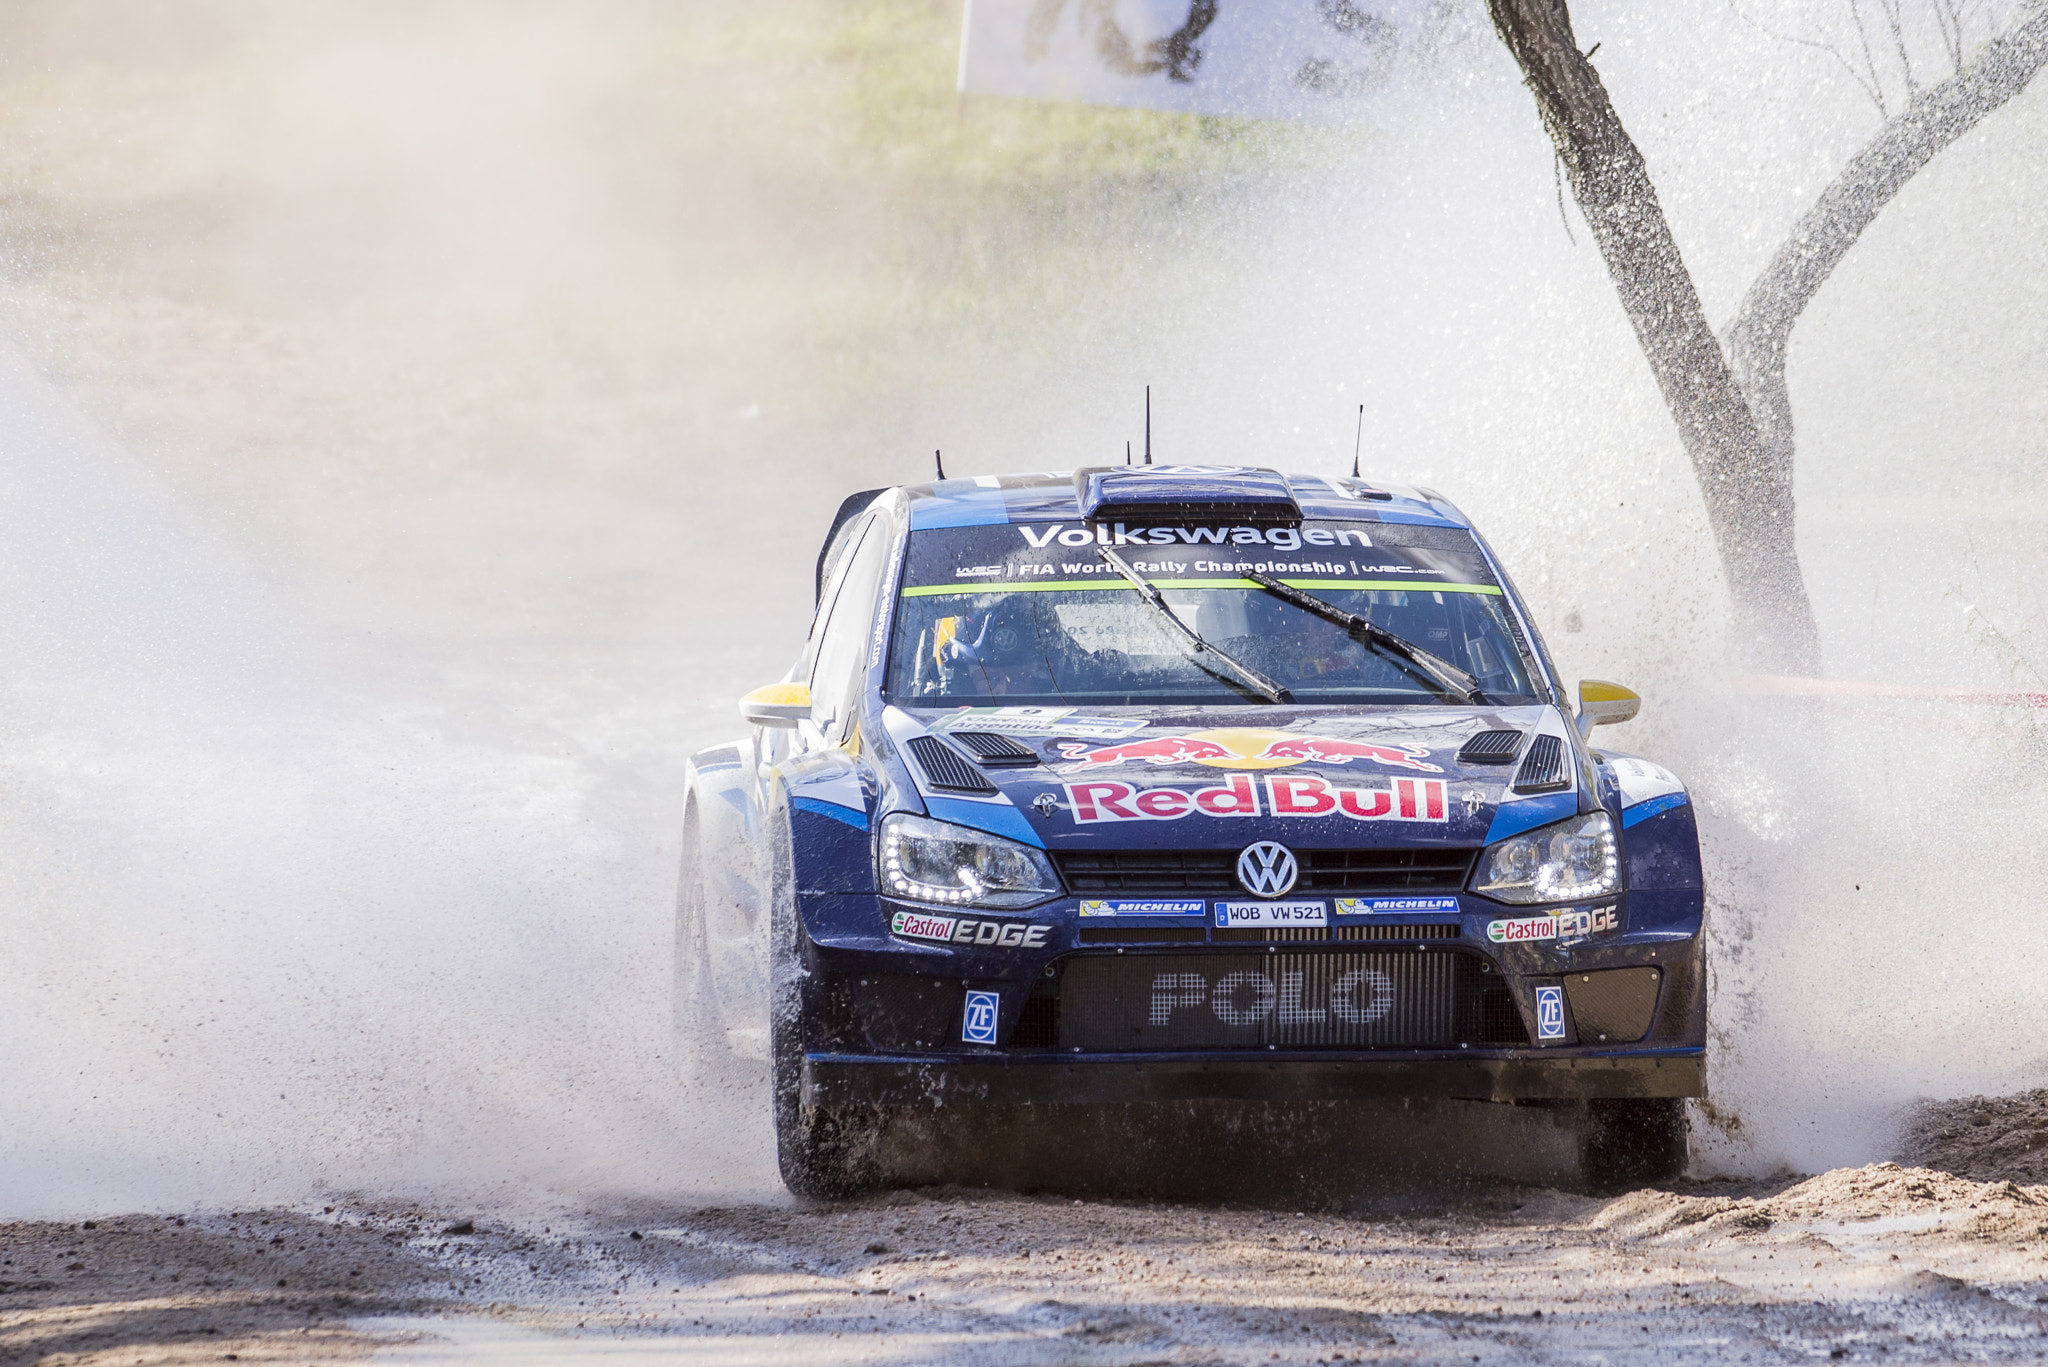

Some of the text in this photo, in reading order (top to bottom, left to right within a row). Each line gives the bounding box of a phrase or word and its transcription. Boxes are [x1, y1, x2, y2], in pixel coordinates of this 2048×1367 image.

[1018, 522, 1373, 551] Volkswagen
[1019, 564, 1056, 576] FIA
[1133, 561, 1187, 575] Rally
[1194, 560, 1347, 576] Championship
[1428, 631, 1448, 640] OMP
[950, 721, 1054, 731] Argentina
[1069, 775, 1445, 821] Red Bull
[1117, 903, 1202, 911] MICHELIN
[1229, 907, 1324, 920] WOB VW 521
[1373, 900, 1455, 909] MICHELIN
[903, 915, 1053, 948] Castrol EDGE
[1506, 905, 1619, 940] Castrol EDGE
[1149, 969, 1394, 1026] POLO
[968, 1003, 994, 1031] ZF
[1541, 999, 1561, 1026] ZF
